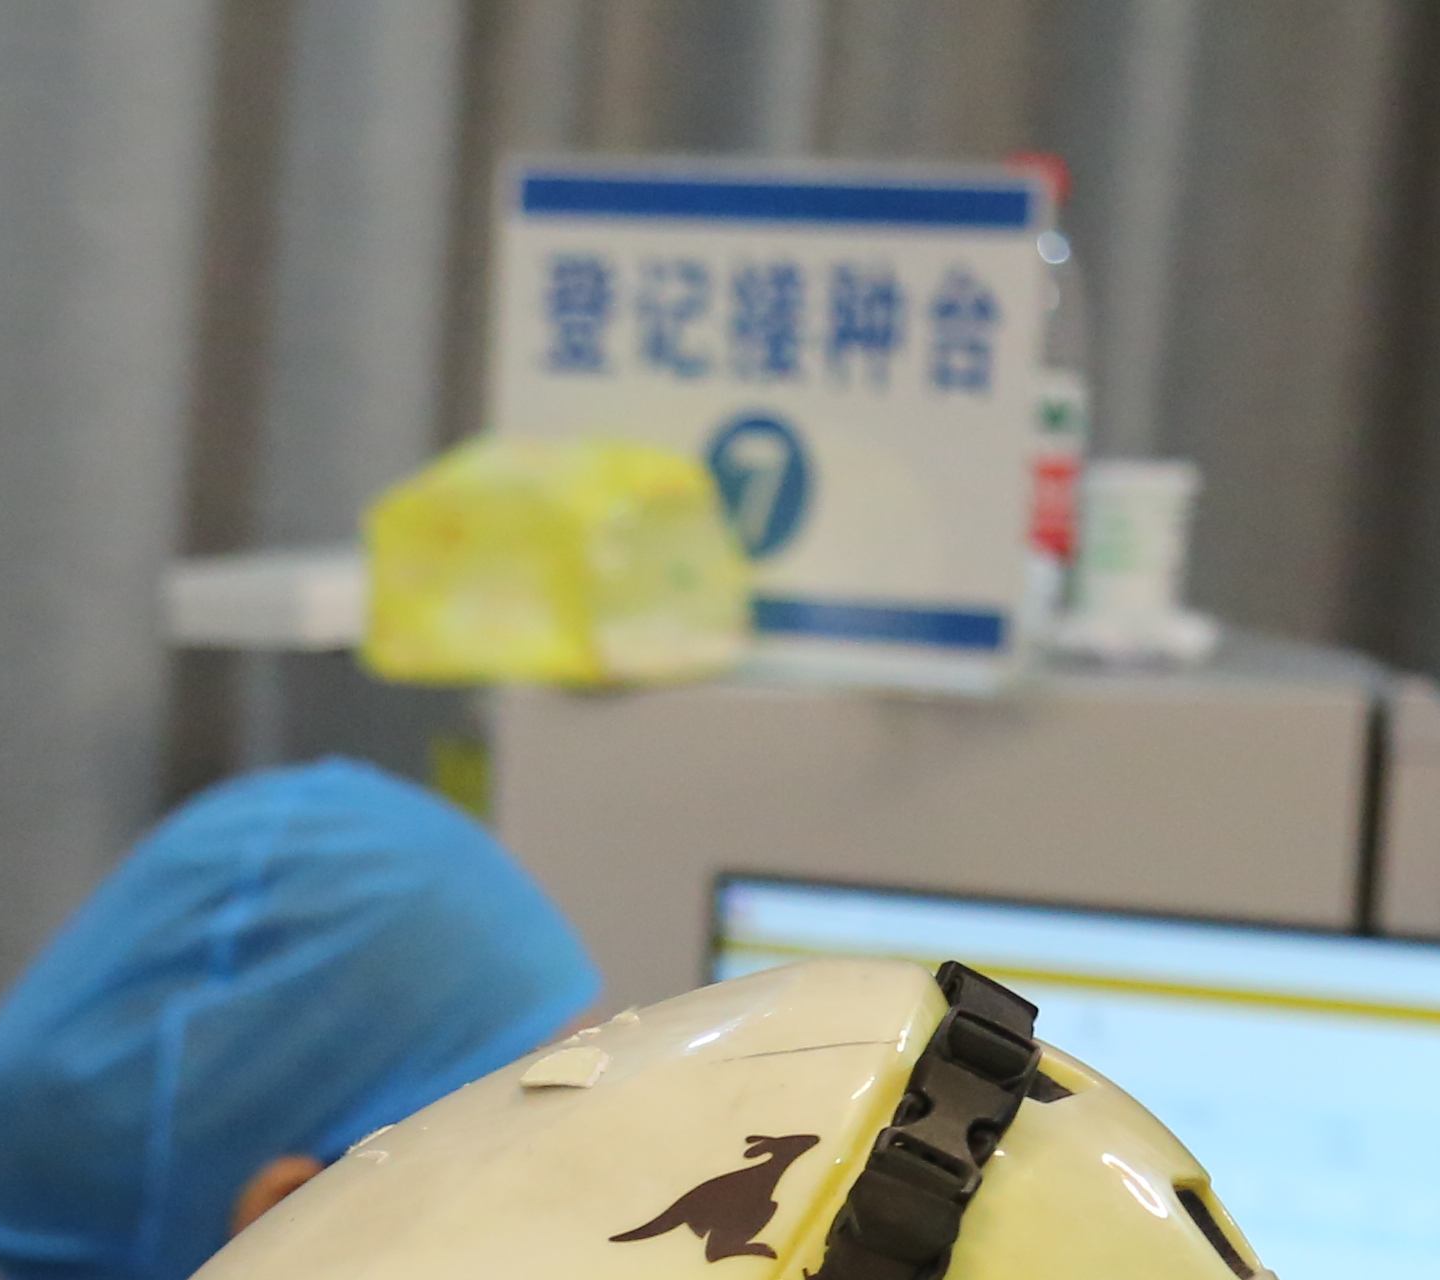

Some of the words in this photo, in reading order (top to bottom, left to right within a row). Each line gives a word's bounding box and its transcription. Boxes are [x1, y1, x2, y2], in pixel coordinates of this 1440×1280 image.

[545, 253, 999, 392] 登记接种台
